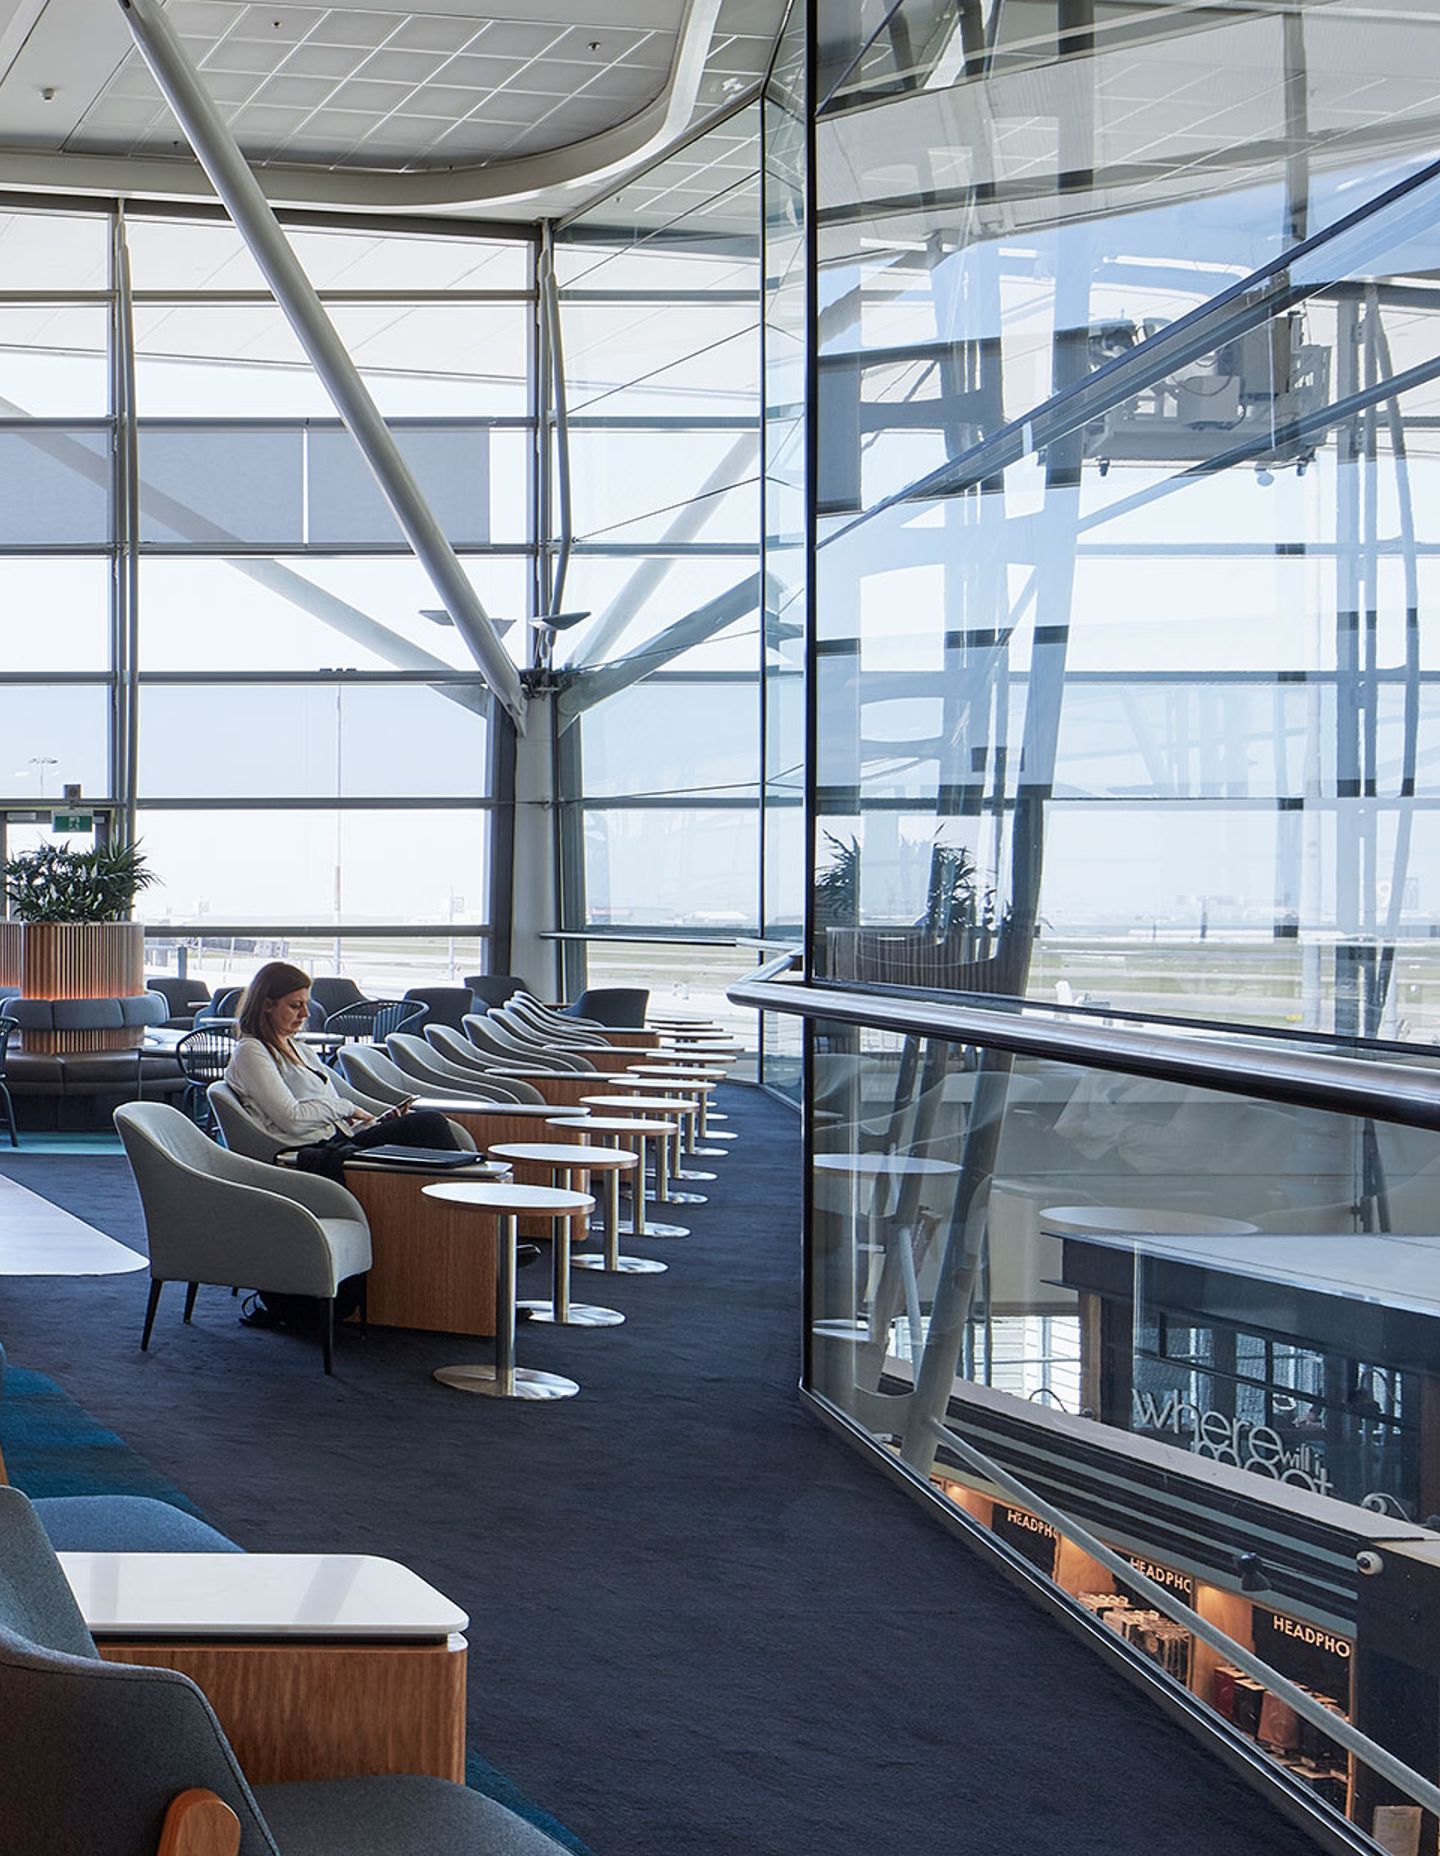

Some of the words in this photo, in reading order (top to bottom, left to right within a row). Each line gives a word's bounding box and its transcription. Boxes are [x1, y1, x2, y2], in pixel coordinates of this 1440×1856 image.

[1131, 1388, 1283, 1464] where
[1281, 1443, 1310, 1472] will
[1273, 1615, 1350, 1657] HEADPHO
